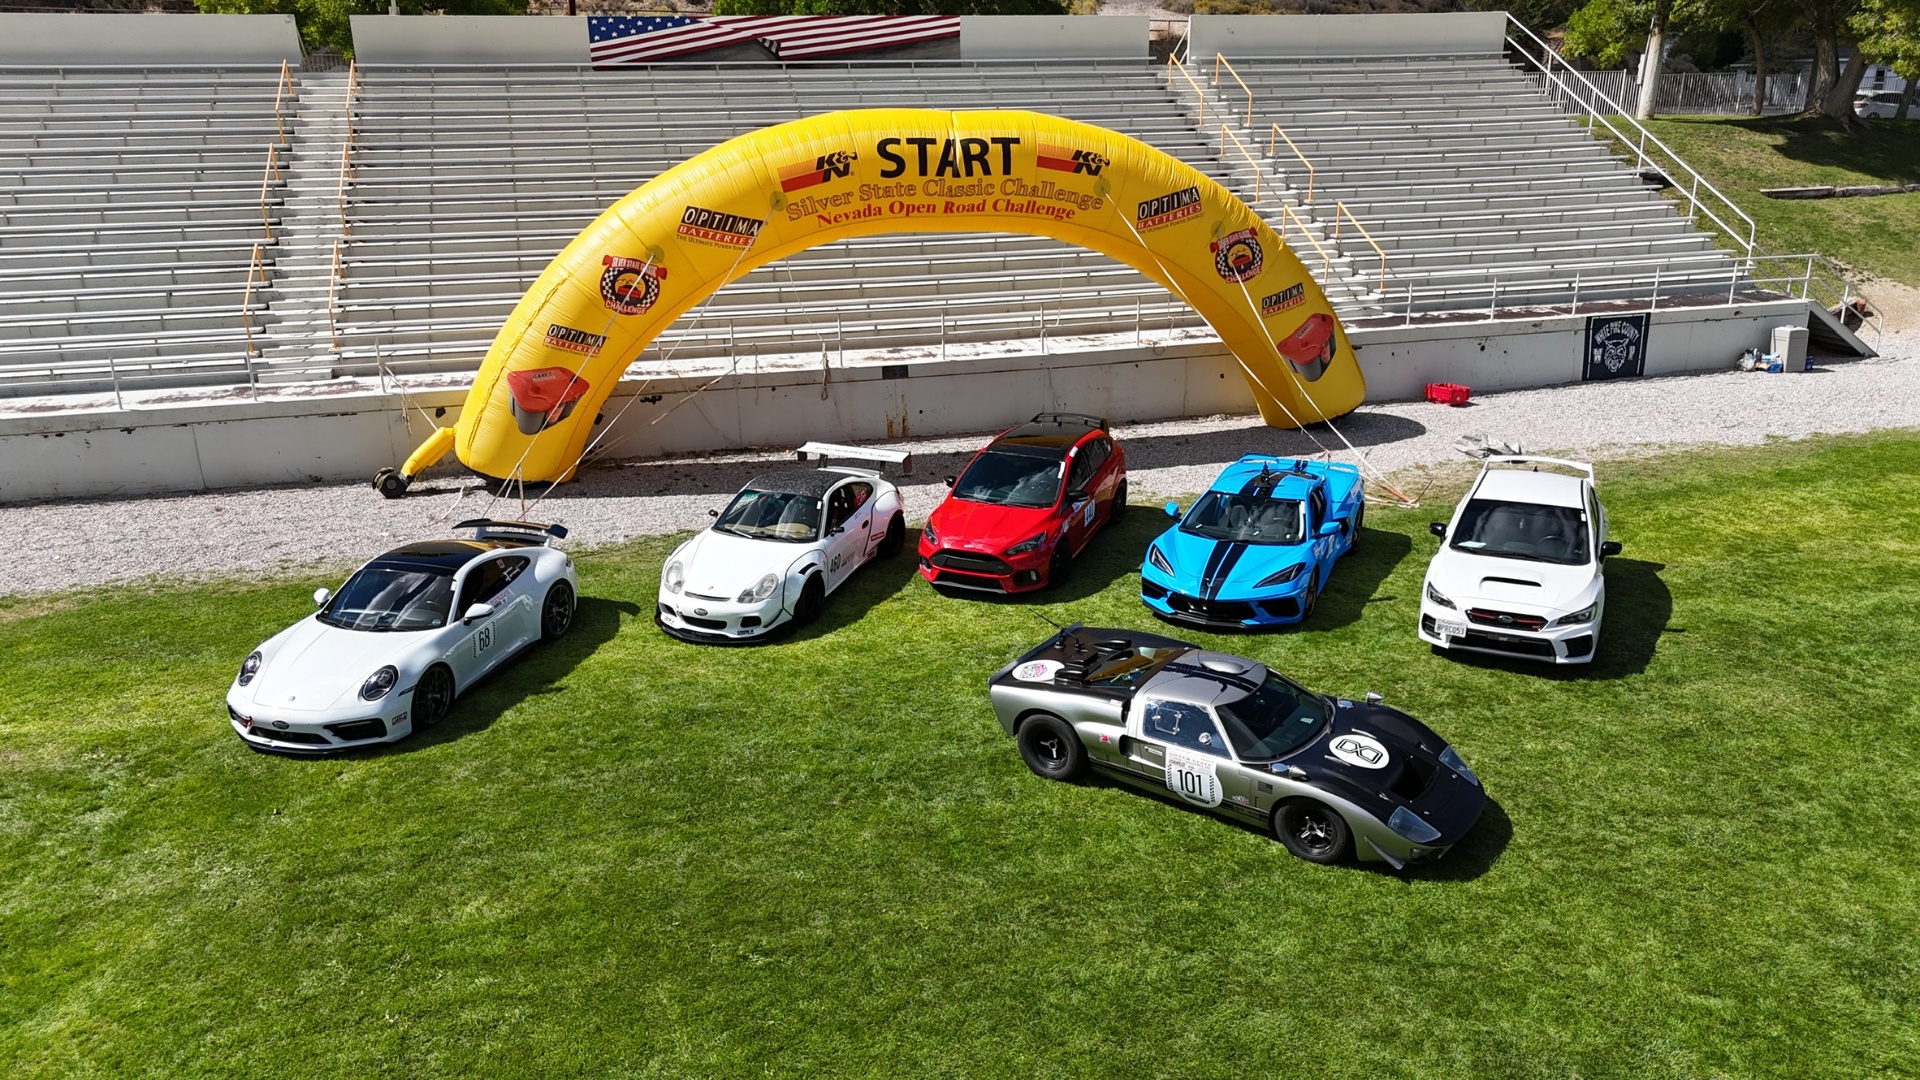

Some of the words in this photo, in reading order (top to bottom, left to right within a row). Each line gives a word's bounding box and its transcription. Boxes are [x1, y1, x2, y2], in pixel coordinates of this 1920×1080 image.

[816, 150, 858, 183] K&N
[876, 137, 1021, 178] START
[1071, 149, 1111, 176] K&N
[786, 190, 854, 222] Silver
[859, 181, 917, 201] State
[922, 178, 995, 198] Classic
[1000, 178, 1104, 211] Challenge
[816, 203, 883, 228] Nevada
[888, 200, 936, 217] Open
[942, 199, 987, 214] Road
[991, 198, 1076, 220] Challenge
[1139, 188, 1199, 219] OPTIMA
[684, 207, 759, 237] OPTIMA
[1137, 203, 1201, 229] BATTERIES
[679, 226, 754, 246] BATTERIES
[1263, 284, 1304, 309] OPTIMA
[548, 325, 604, 347] OPTIMA
[478, 627, 491, 651] 68
[1177, 769, 1203, 797] 101
